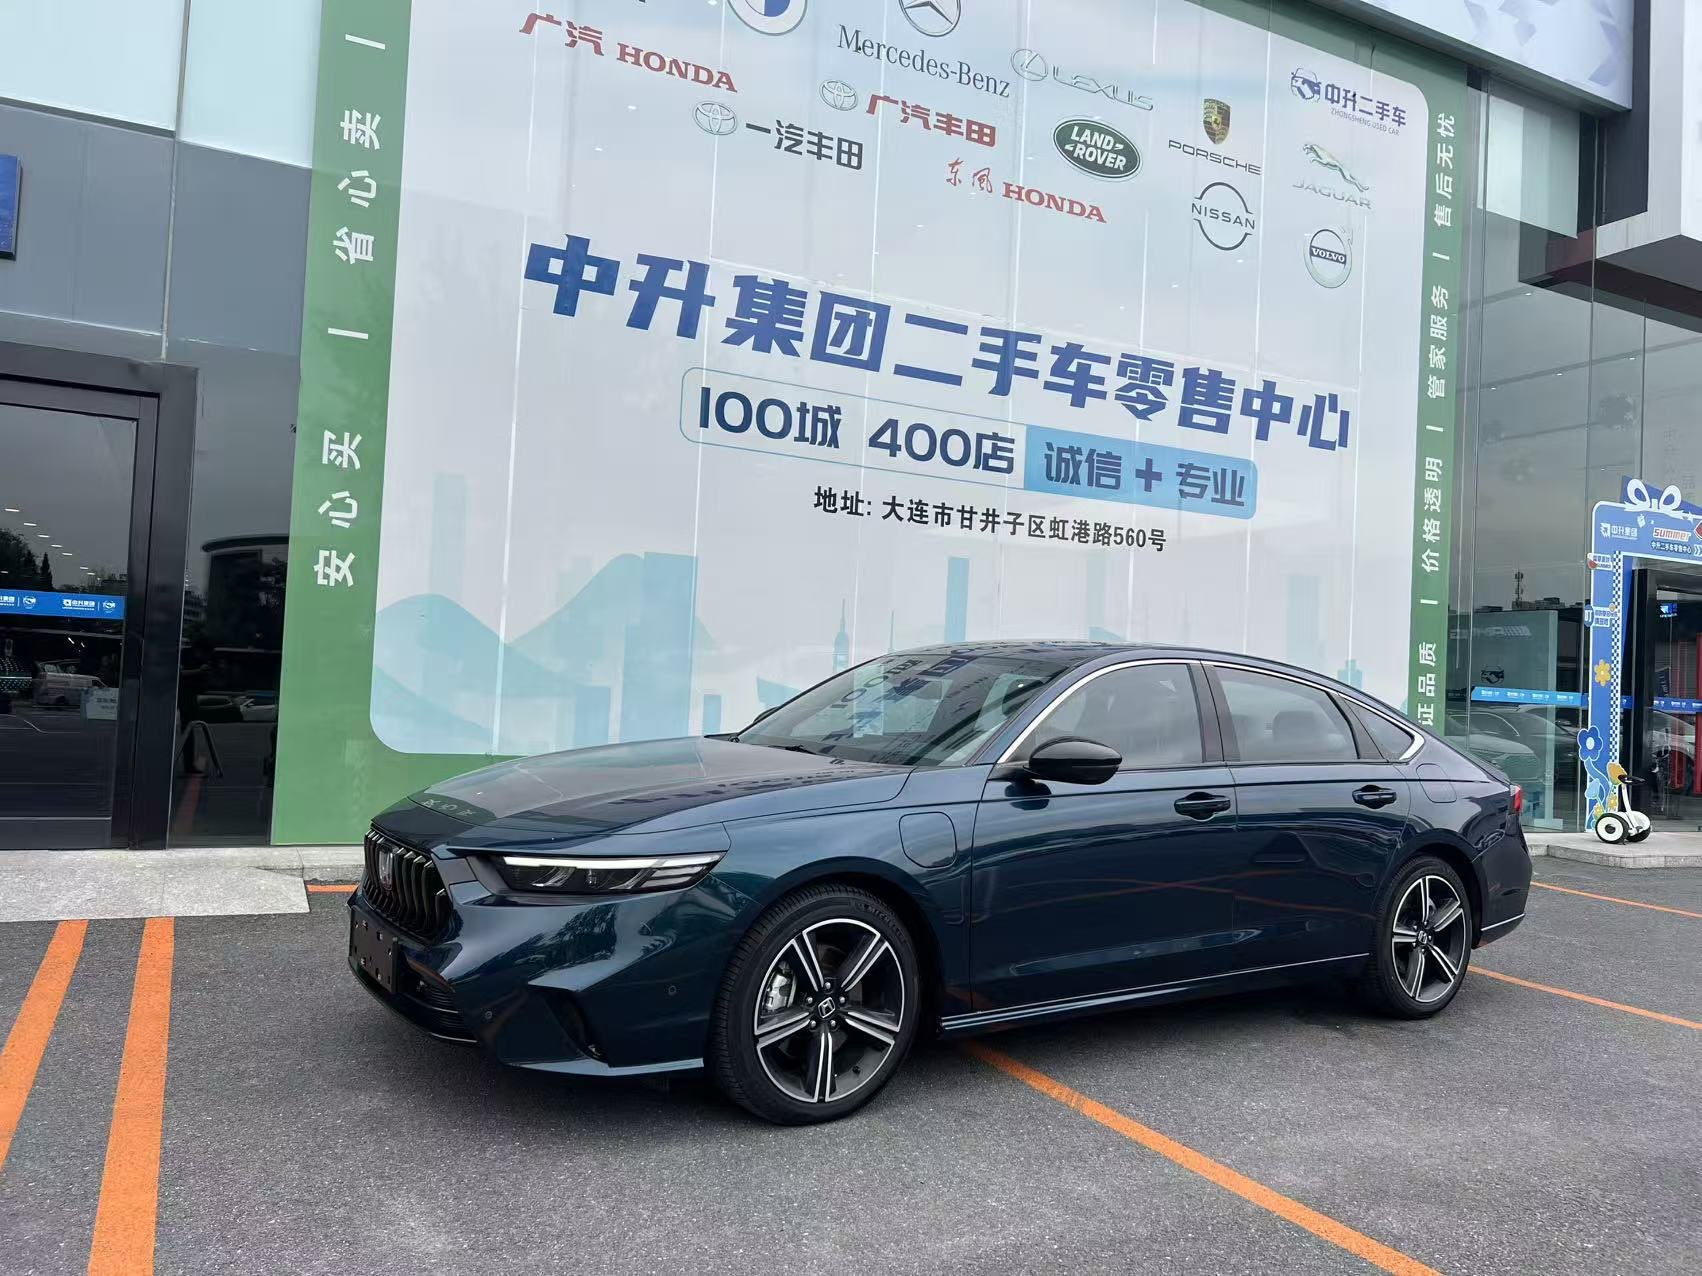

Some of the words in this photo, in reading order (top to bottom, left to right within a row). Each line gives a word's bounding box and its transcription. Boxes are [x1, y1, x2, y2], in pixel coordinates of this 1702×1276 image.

[519, 13, 604, 57] 广汽
[616, 42, 738, 93] HONDA
[837, 24, 1010, 98] Mercedes-Benz
[1053, 65, 1154, 111] LEXUS
[1325, 83, 1407, 127] 中升二手车
[745, 119, 864, 170] 一汽丰田
[866, 94, 996, 148] 广汽丰田
[1070, 125, 1115, 151] LAND
[1331, 108, 1371, 127] ZHONGSHENG
[1372, 122, 1387, 132] USED
[1388, 127, 1400, 136] CAR
[332, 109, 382, 265] 省心卖
[1076, 146, 1127, 171] ROVER
[1168, 139, 1262, 176] PORSCHE
[1433, 112, 1456, 227] 售后无忧
[946, 157, 993, 194] 东风
[1002, 182, 1107, 224] HONDA
[1191, 202, 1256, 230] NISSAN
[1292, 179, 1372, 210] JAGUAR
[1312, 247, 1345, 263] VOLVO
[524, 233, 1350, 452] 中升集团二手车零售中心
[1427, 284, 1449, 399] 管家服务
[699, 386, 843, 449] 100城
[868, 417, 1016, 475] 400店
[1043, 441, 1122, 491] 诚信
[1175, 461, 1246, 508] 专业
[313, 429, 362, 587] 安心买
[1421, 456, 1443, 573] 价格透明
